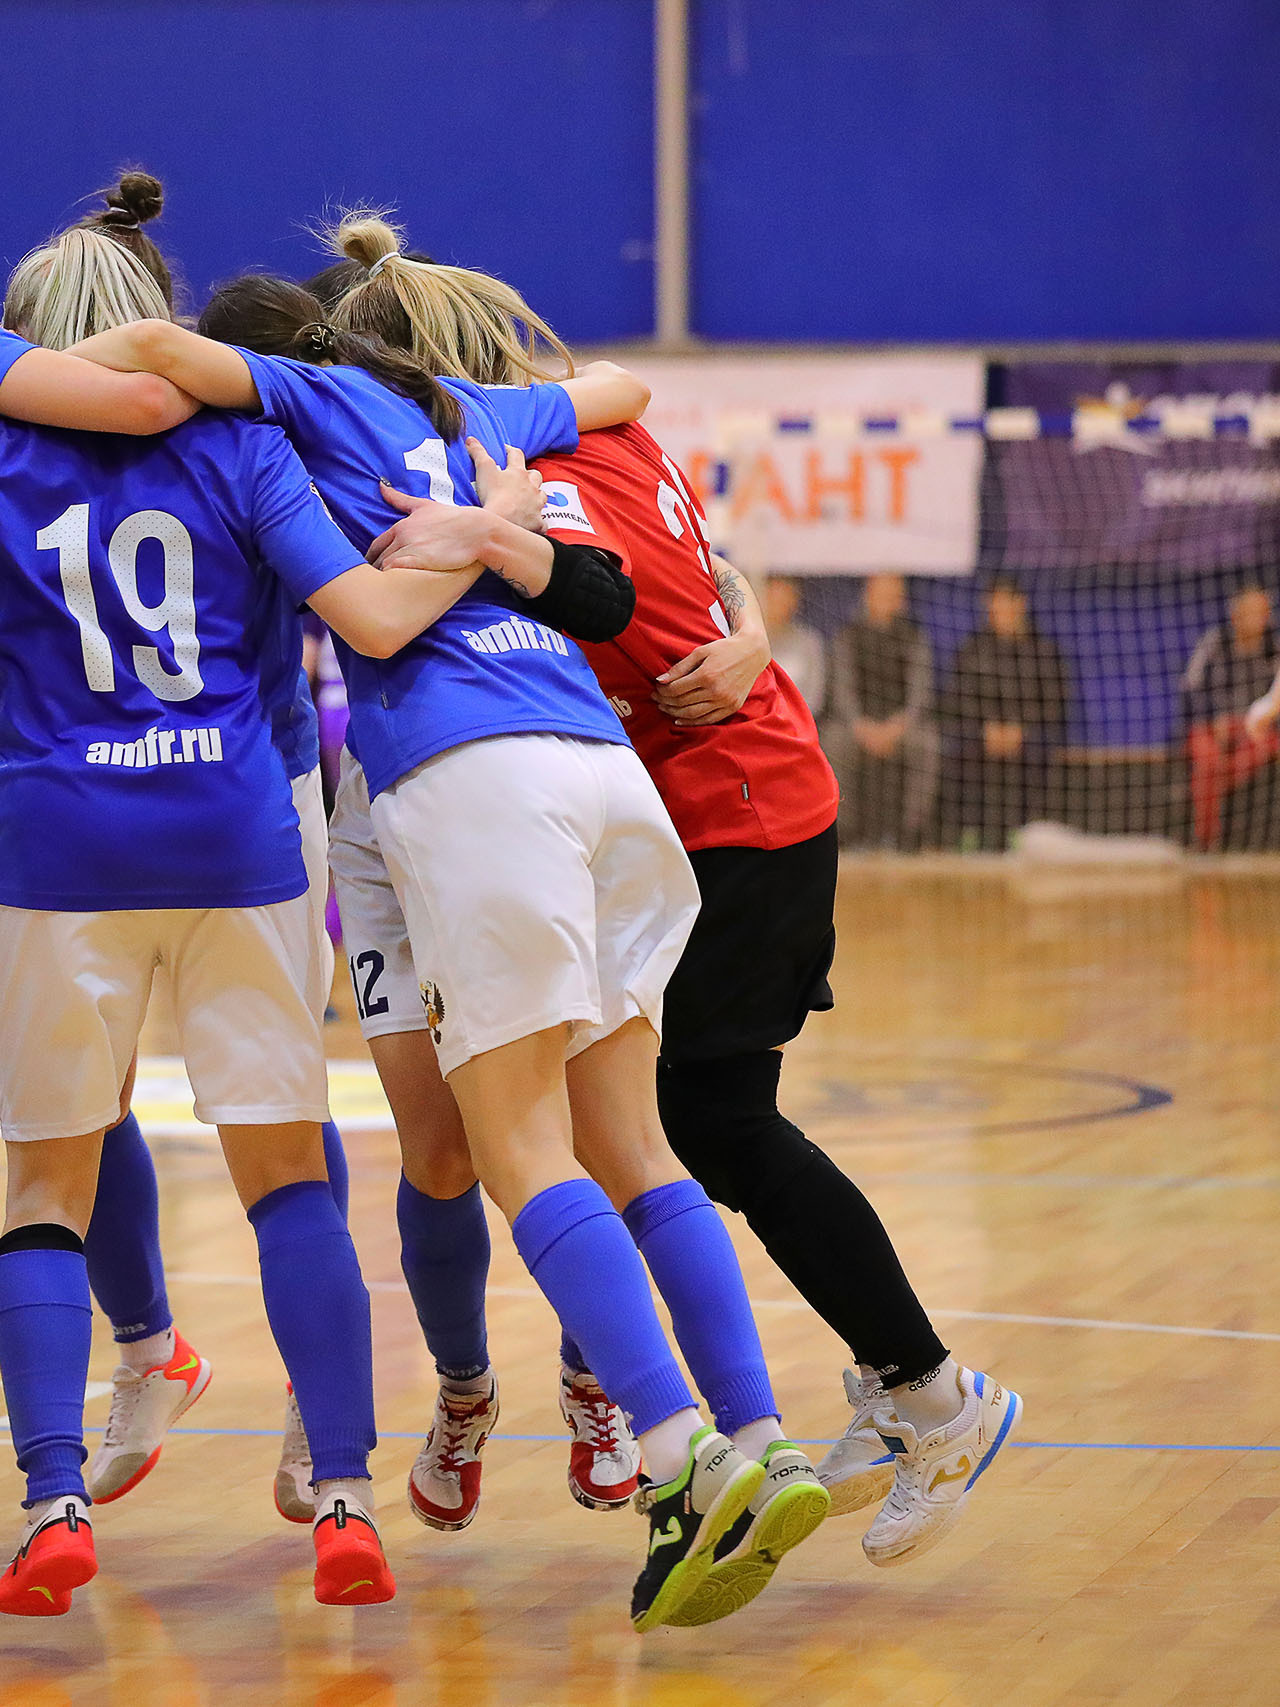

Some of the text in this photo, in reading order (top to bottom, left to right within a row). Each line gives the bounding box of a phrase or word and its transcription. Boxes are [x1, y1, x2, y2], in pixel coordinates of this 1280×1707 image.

[36, 503, 205, 701] 19
[460, 615, 569, 657] amfr.ru
[85, 726, 223, 767] amfr.ru
[908, 1367, 941, 1392] adidas
